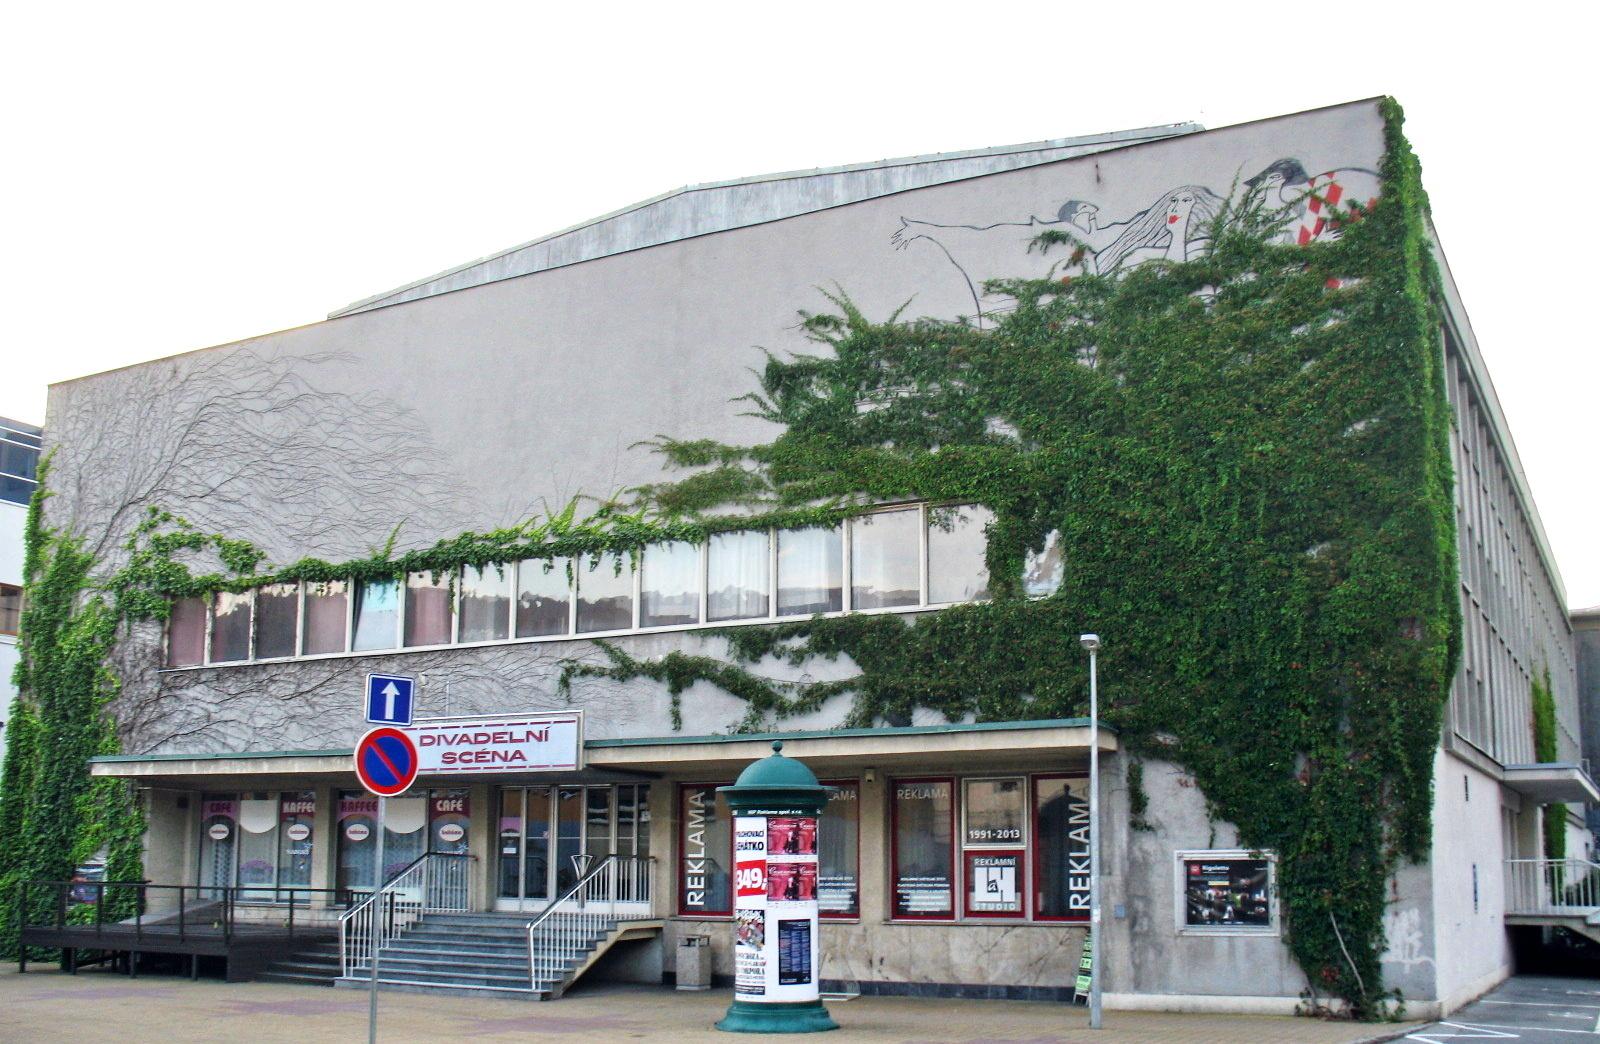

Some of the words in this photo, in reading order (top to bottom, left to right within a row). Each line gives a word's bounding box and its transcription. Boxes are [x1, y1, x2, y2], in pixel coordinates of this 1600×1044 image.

[419, 726, 551, 747] DIVADELNÍ
[441, 748, 528, 765] SCÉNA
[896, 788, 949, 801] REKLAMA
[341, 800, 378, 813] KAFFEE
[436, 798, 464, 813] CAFÉ
[968, 829, 1020, 840] 1991-2013
[687, 791, 705, 906] REKLAMA
[974, 856, 1016, 867] REKLAMNÍ
